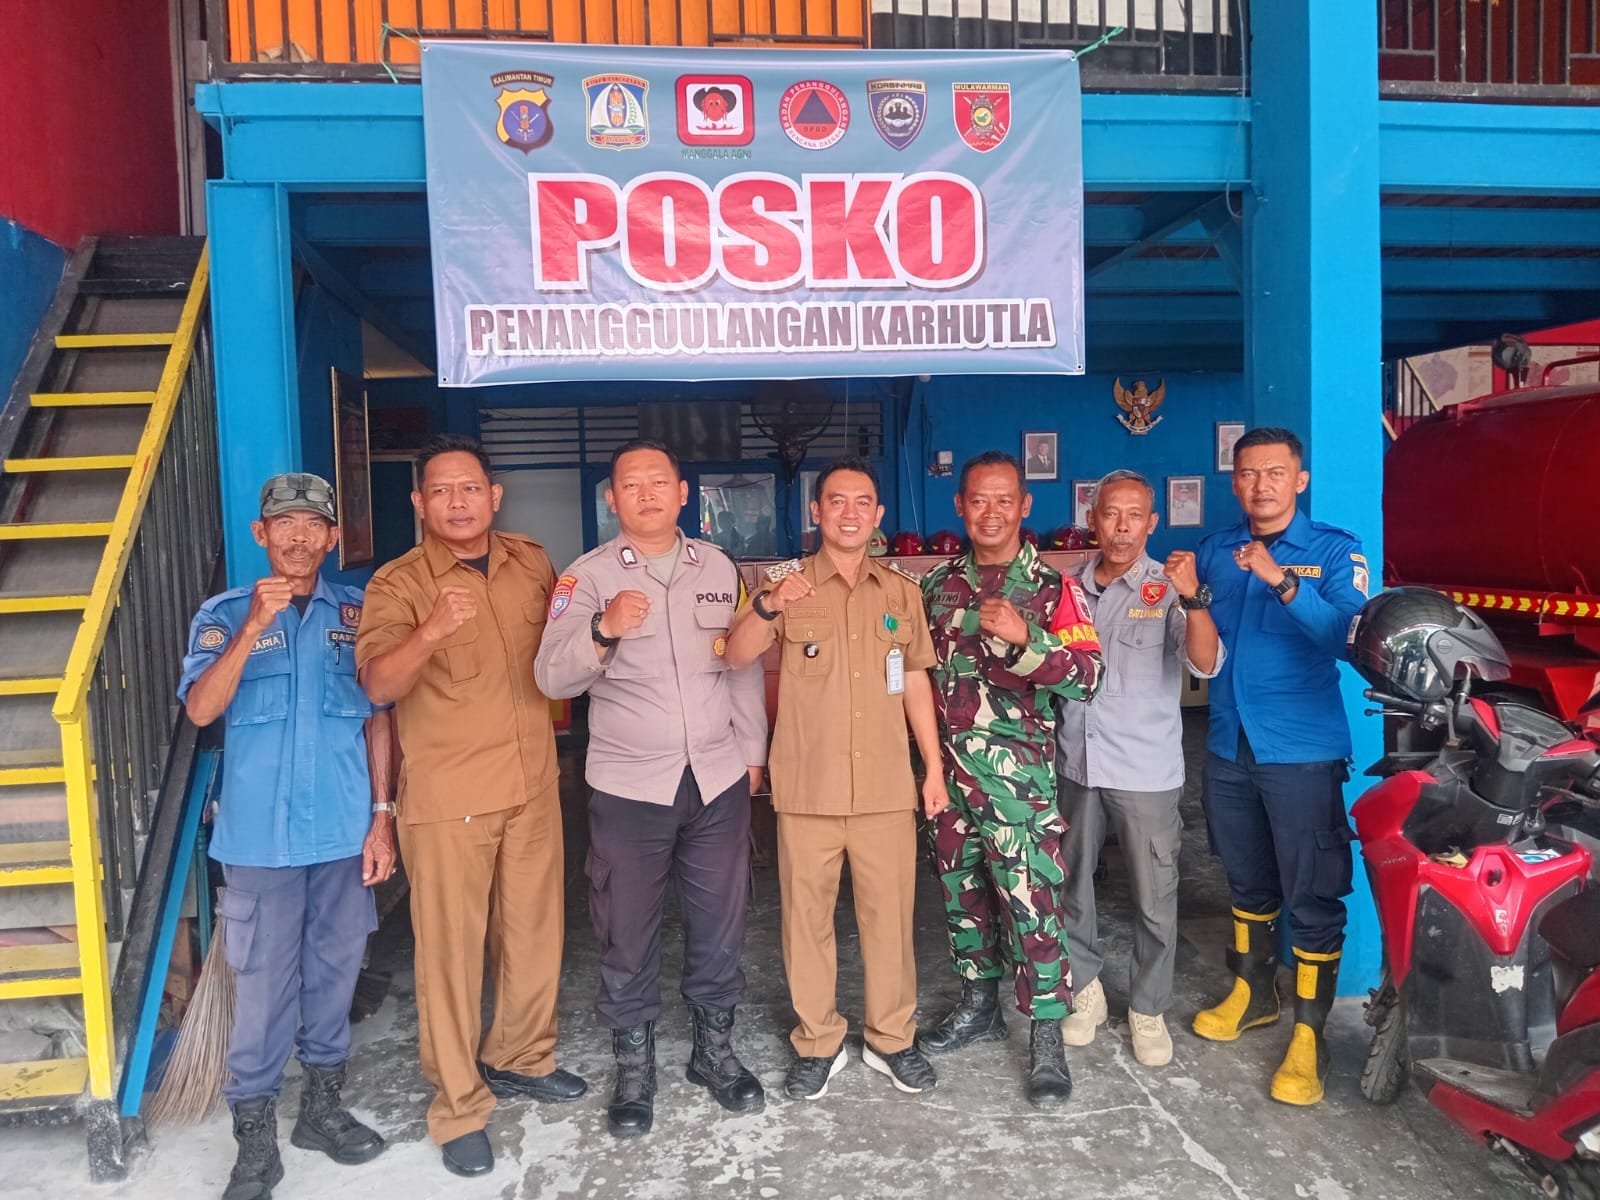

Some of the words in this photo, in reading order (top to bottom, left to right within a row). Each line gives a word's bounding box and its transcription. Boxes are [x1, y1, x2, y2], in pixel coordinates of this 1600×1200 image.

[493, 73, 532, 85] KALIMANTAN
[533, 74, 552, 85] TIMUR
[781, 96, 791, 128] BADAN
[530, 173, 982, 289] POSKO
[466, 302, 854, 354] PENANGGUULANGAN
[859, 299, 1055, 349] KARHUTLA
[696, 592, 733, 604] POLRI
[252, 636, 281, 650] ARIA
